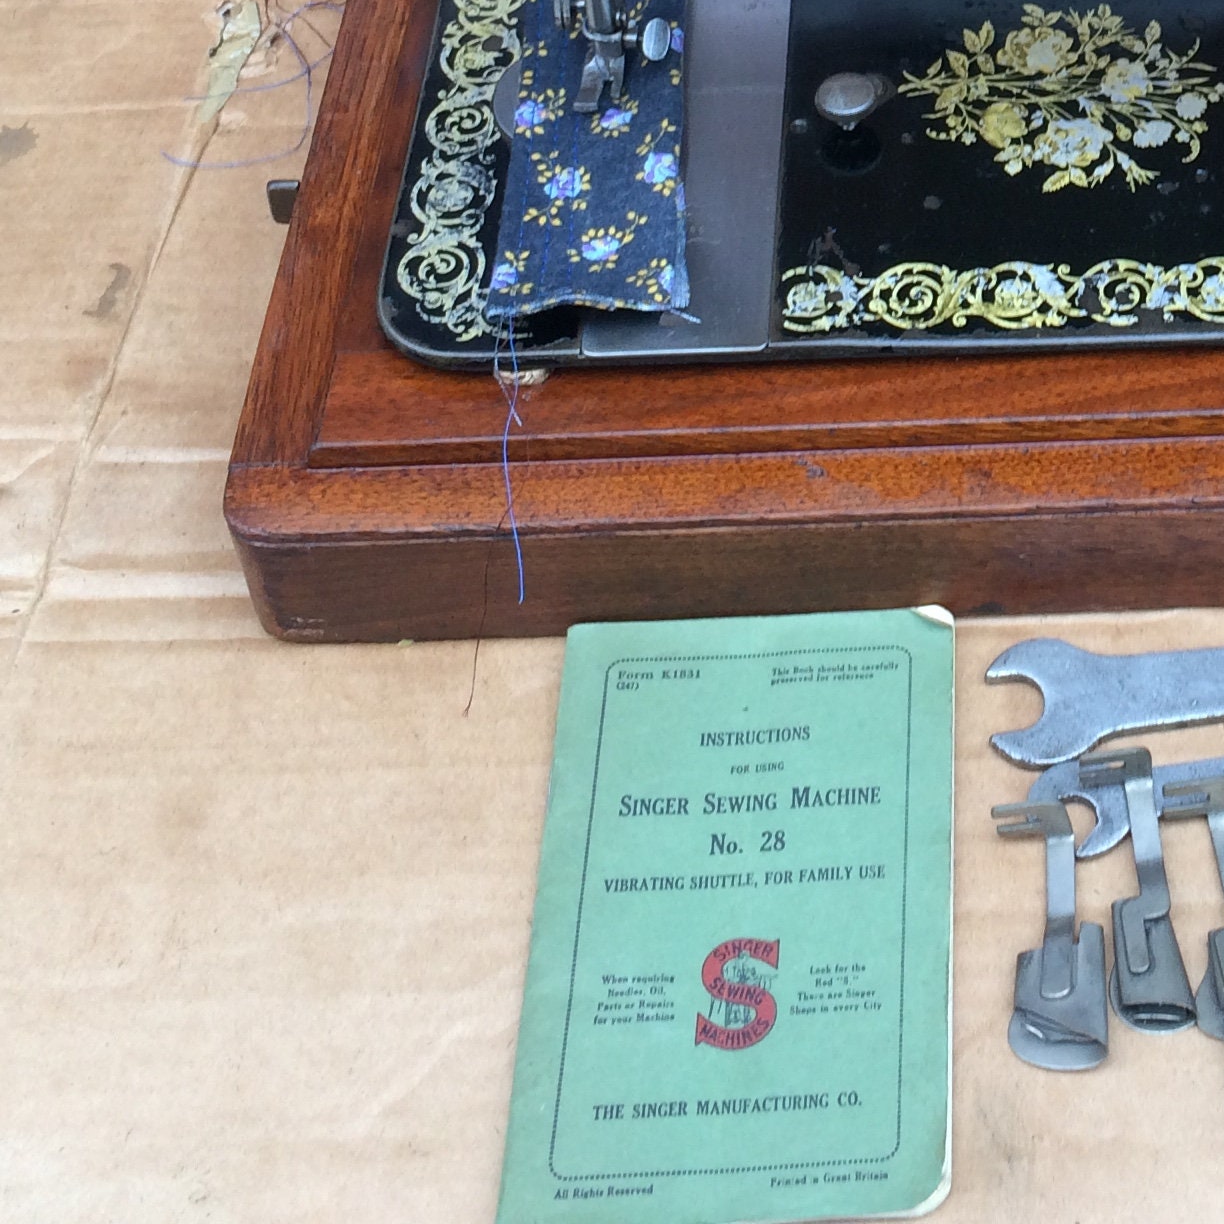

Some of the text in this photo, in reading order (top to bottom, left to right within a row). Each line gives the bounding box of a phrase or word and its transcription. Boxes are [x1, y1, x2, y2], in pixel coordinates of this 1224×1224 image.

[617, 670, 654, 680] Form
[772, 666, 790, 676] This
[817, 663, 845, 673] should
[848, 663, 858, 672] be
[861, 661, 899, 671] carefully
[771, 672, 874, 686] preserved for reference
[699, 725, 811, 747] INSTRUCTIONS
[730, 761, 785, 775] FOR USING
[618, 785, 882, 817] SINGER SEWING MACHINE
[709, 829, 786, 856] No. 28
[603, 863, 887, 893] VIBRATING SHUTTLE, FOR FAMILY USE
[712, 938, 774, 962] SINGER
[809, 962, 866, 975] Look for the
[602, 973, 675, 984] When requiring
[815, 977, 833, 987] Red
[709, 977, 763, 1006] SEWING
[827, 992, 842, 1000] are
[845, 987, 876, 998] Singer
[597, 999, 674, 1012] Parts or Repairs
[790, 1000, 882, 1015] Shops in every City
[593, 1012, 675, 1025] for your Machine
[699, 1016, 771, 1047] MACHINES
[592, 1090, 862, 1121] THE SINGER MANUFACTURING CO.
[770, 1175, 807, 1188] Printed
[823, 1172, 850, 1183] Great
[855, 1170, 889, 1182] Britain
[553, 1183, 654, 1200] All Rights Reserved
